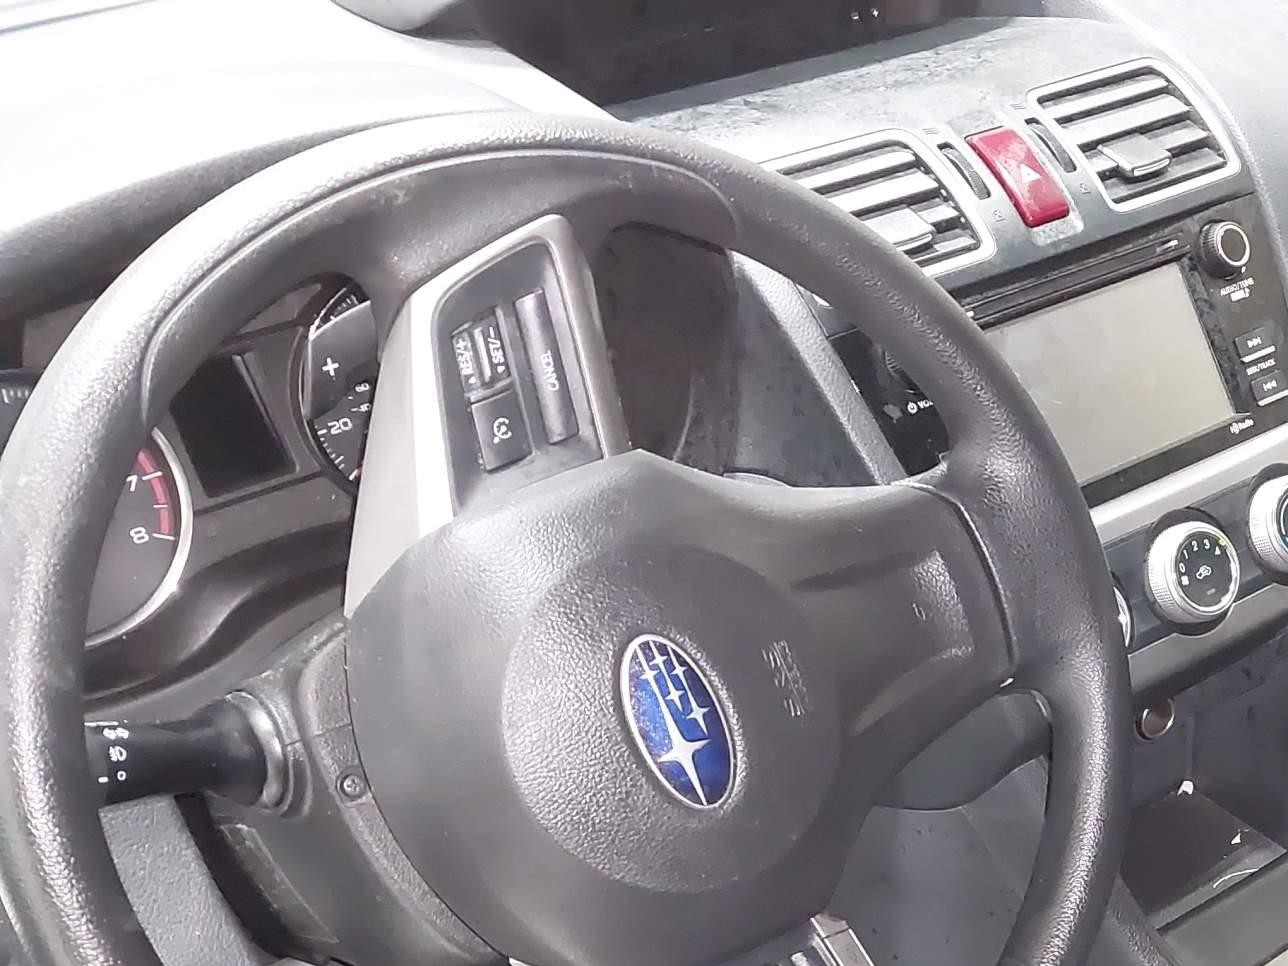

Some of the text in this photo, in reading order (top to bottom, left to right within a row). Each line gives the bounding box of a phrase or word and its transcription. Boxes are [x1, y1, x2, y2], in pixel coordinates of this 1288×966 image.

[540, 350, 560, 391] CANCEL
[327, 417, 353, 435] 20
[125, 474, 138, 492] 7
[129, 526, 149, 544] 8
[1203, 538, 1211, 550] 3
[1191, 540, 1199, 552] 2
